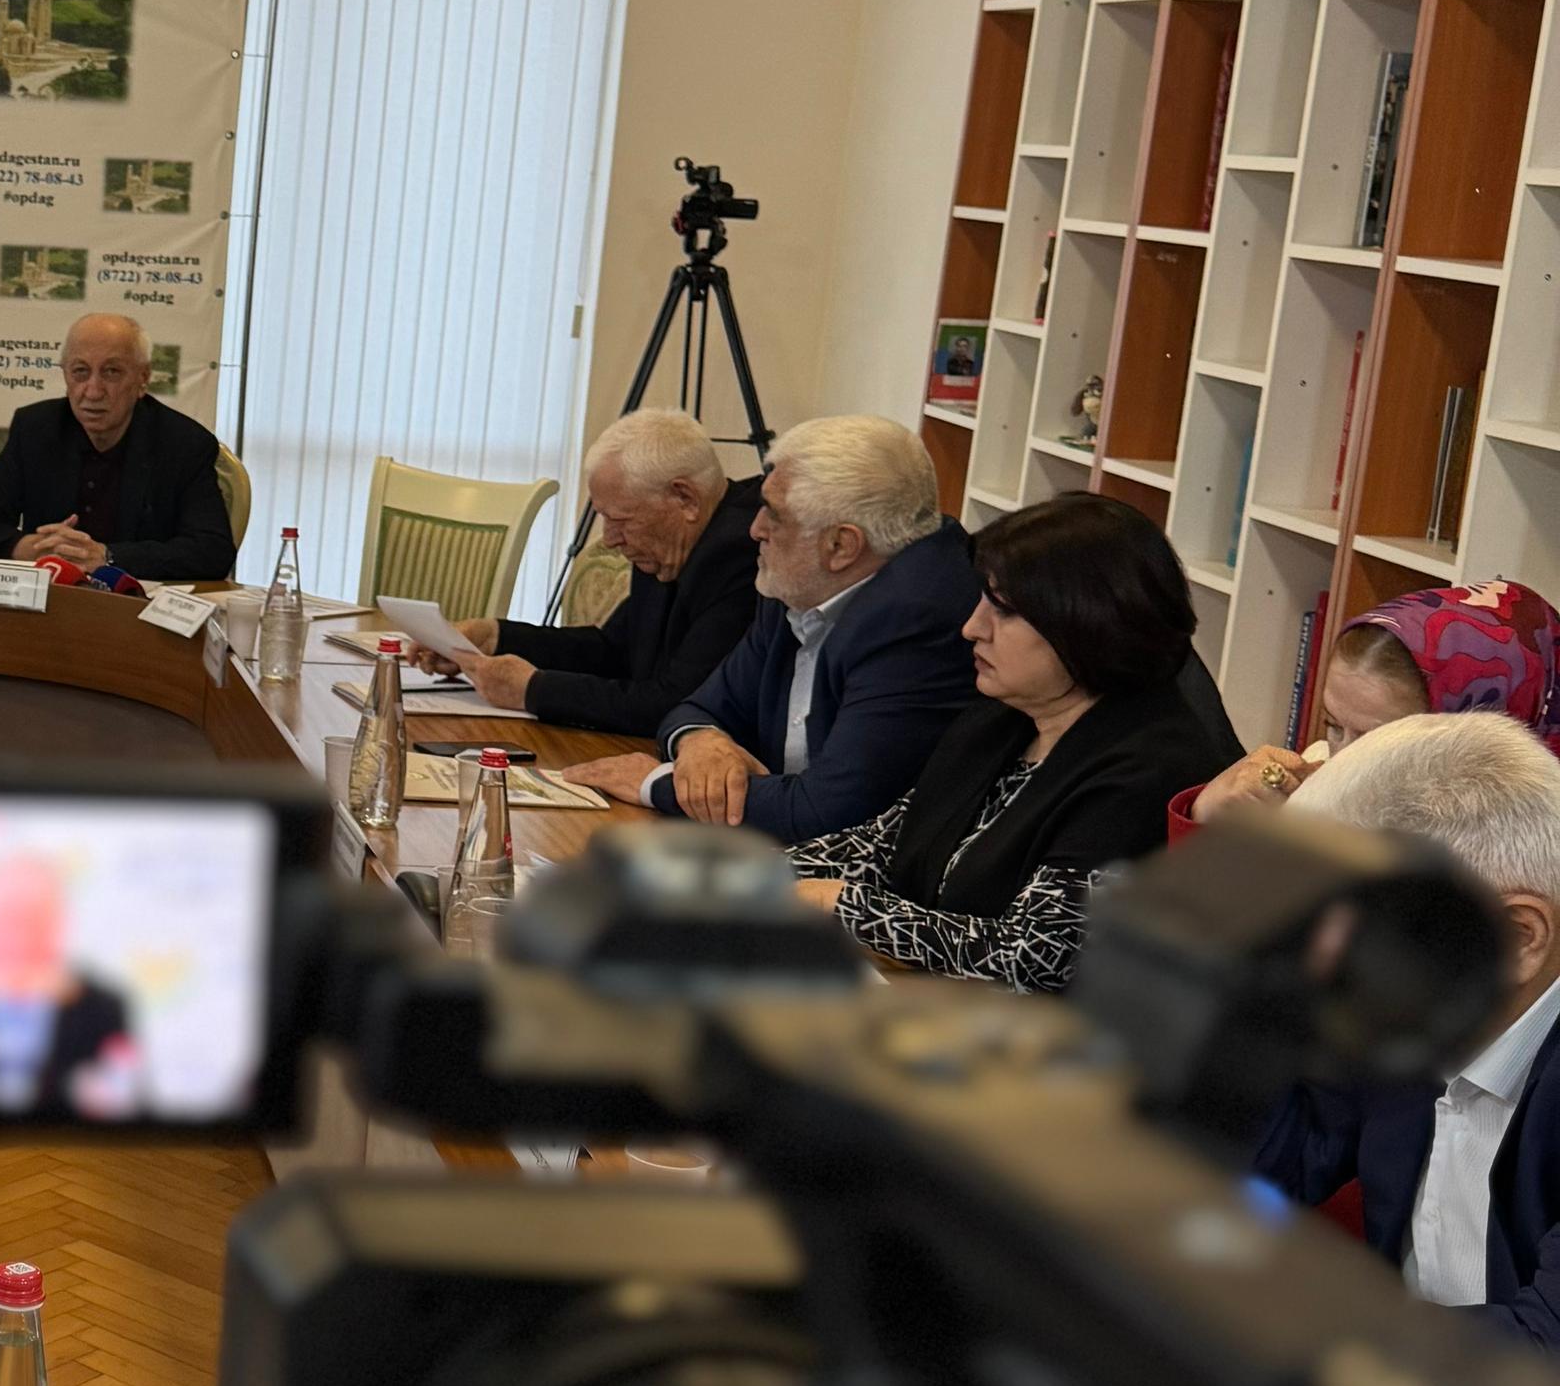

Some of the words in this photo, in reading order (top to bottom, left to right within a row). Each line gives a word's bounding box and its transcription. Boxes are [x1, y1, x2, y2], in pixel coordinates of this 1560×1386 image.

[24, 171, 84, 186] 78-08-43
[3, 190, 54, 208] #opdag
[102, 251, 200, 267] opdagestan.ru
[97, 269, 141, 285] (8722)
[145, 271, 203, 285] 78-08-43
[123, 289, 174, 306] #opdag
[14, 355, 64, 370] 78-08-
